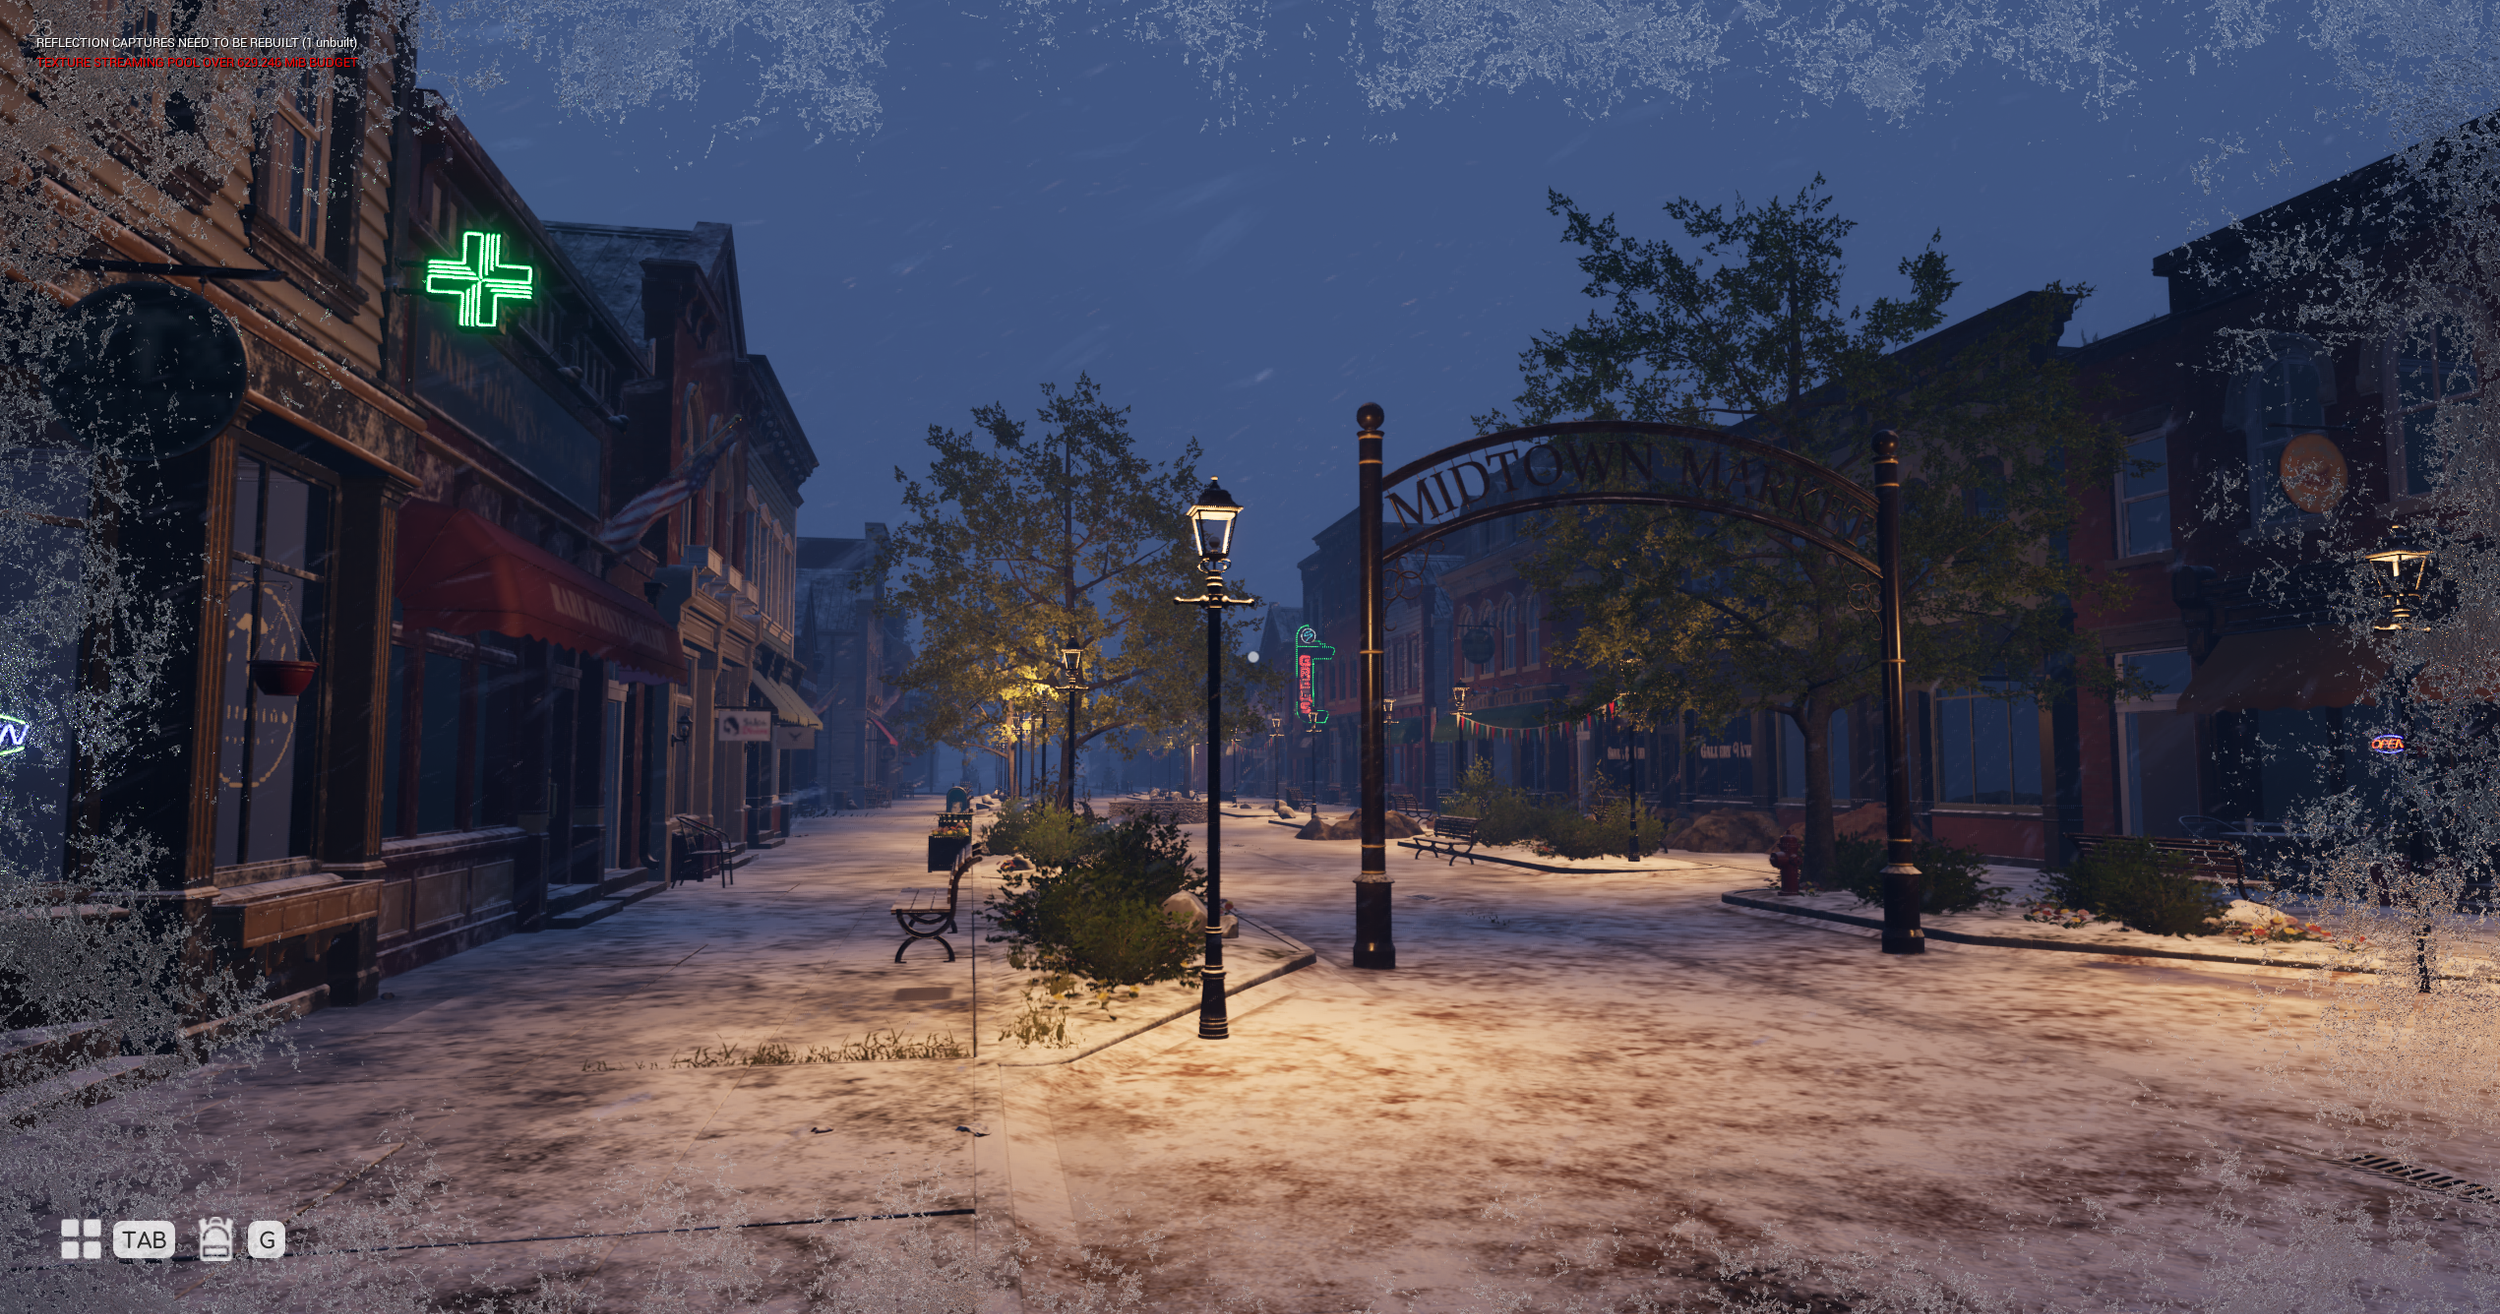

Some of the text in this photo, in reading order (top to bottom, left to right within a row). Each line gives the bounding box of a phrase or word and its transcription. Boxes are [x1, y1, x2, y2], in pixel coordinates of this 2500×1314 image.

[1384, 441, 1877, 547] MIDTOWN MARKET
[2371, 738, 2405, 749] OPEN
